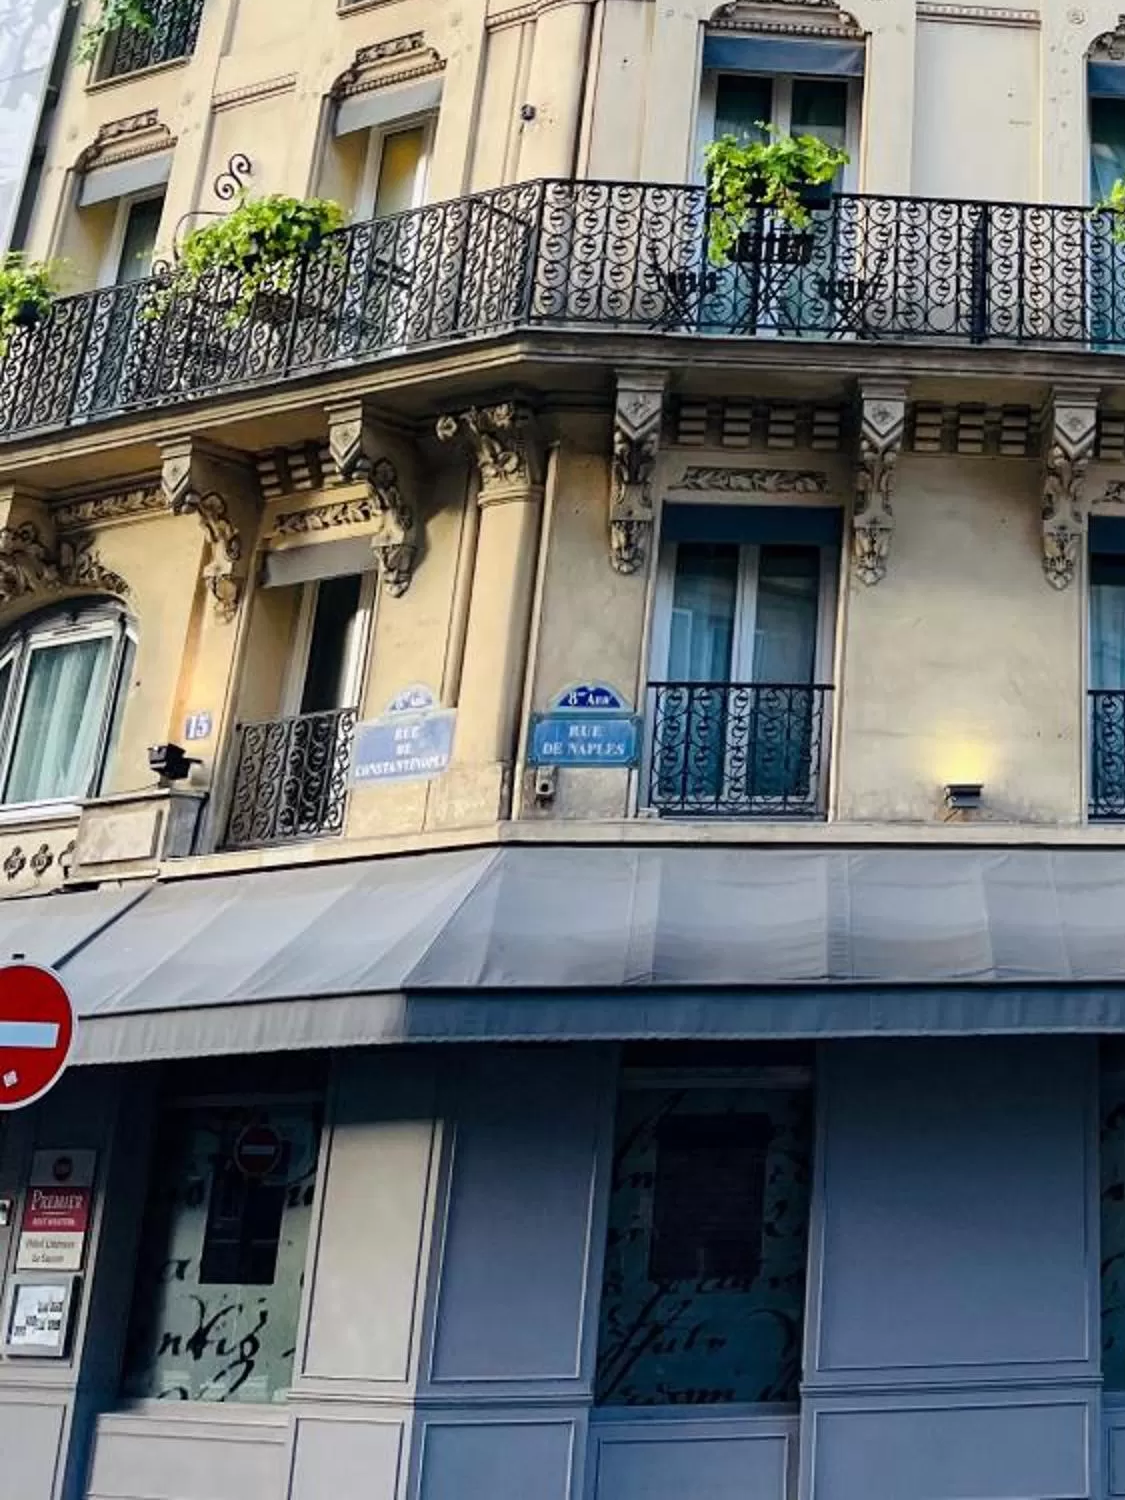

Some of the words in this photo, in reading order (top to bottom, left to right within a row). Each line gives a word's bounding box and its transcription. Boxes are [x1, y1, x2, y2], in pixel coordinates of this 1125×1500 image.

[568, 725, 605, 738] RUE
[542, 742, 563, 755] DE
[567, 742, 625, 756] NAPLES
